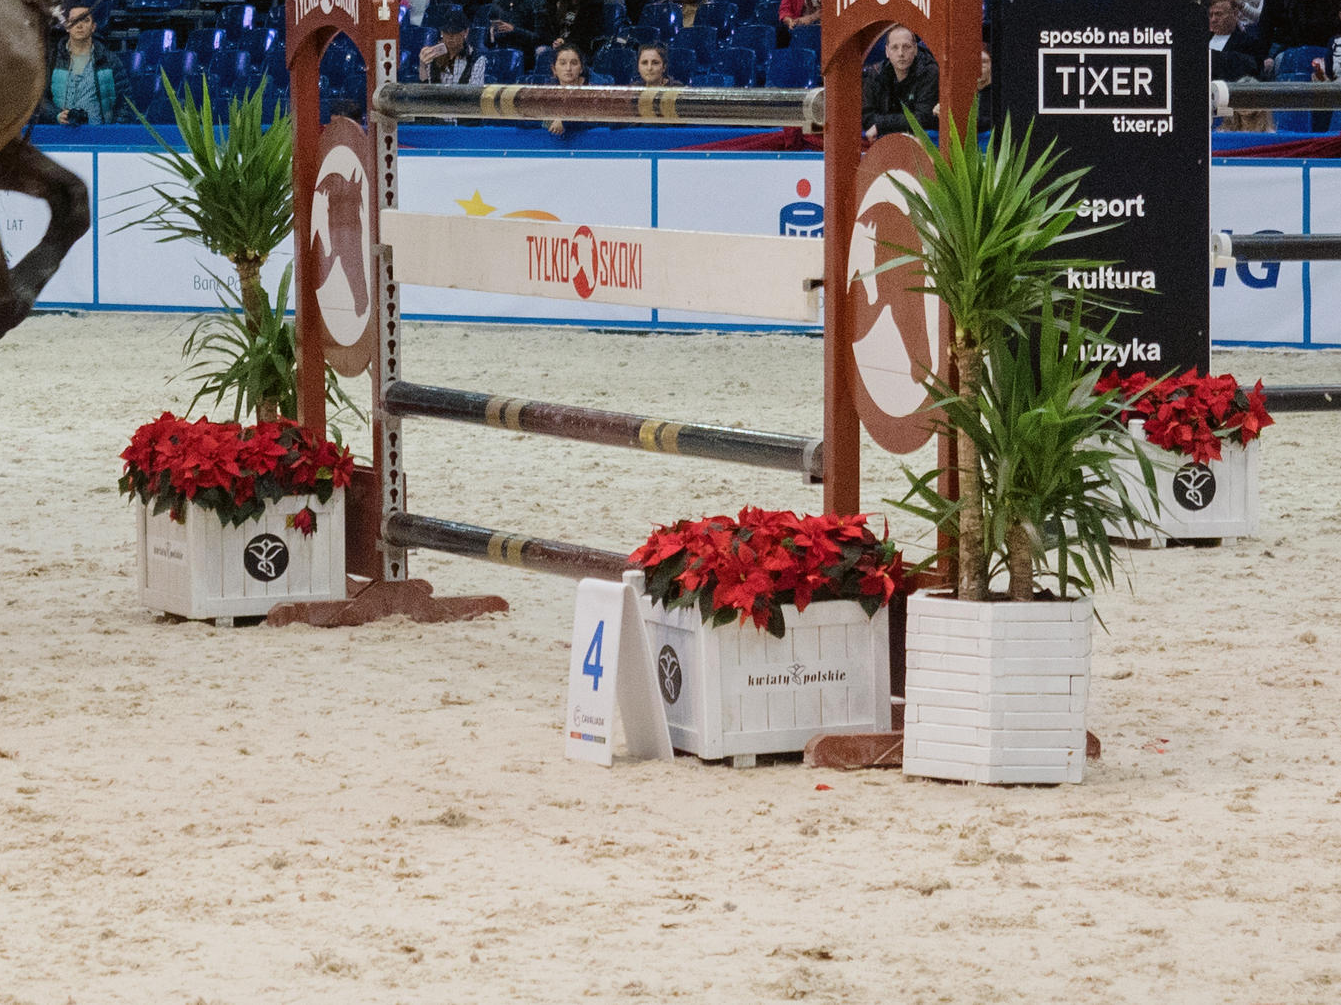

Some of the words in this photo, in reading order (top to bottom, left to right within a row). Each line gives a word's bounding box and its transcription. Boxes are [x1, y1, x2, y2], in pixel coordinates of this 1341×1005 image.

[1039, 27, 1105, 48] sposób
[1109, 30, 1129, 44] na
[1133, 27, 1173, 45] bilet
[1112, 116, 1173, 137] tixer.pl
[1076, 194, 1145, 223] sport
[6, 219, 23, 231] LAT
[525, 235, 569, 283] TYLKO
[600, 240, 642, 290] SKOKI
[193, 275, 222, 291] Bank
[1067, 266, 1156, 290] kultura
[582, 620, 604, 691] 4
[748, 674, 790, 687] kwiaty
[803, 669, 847, 685] polskie
